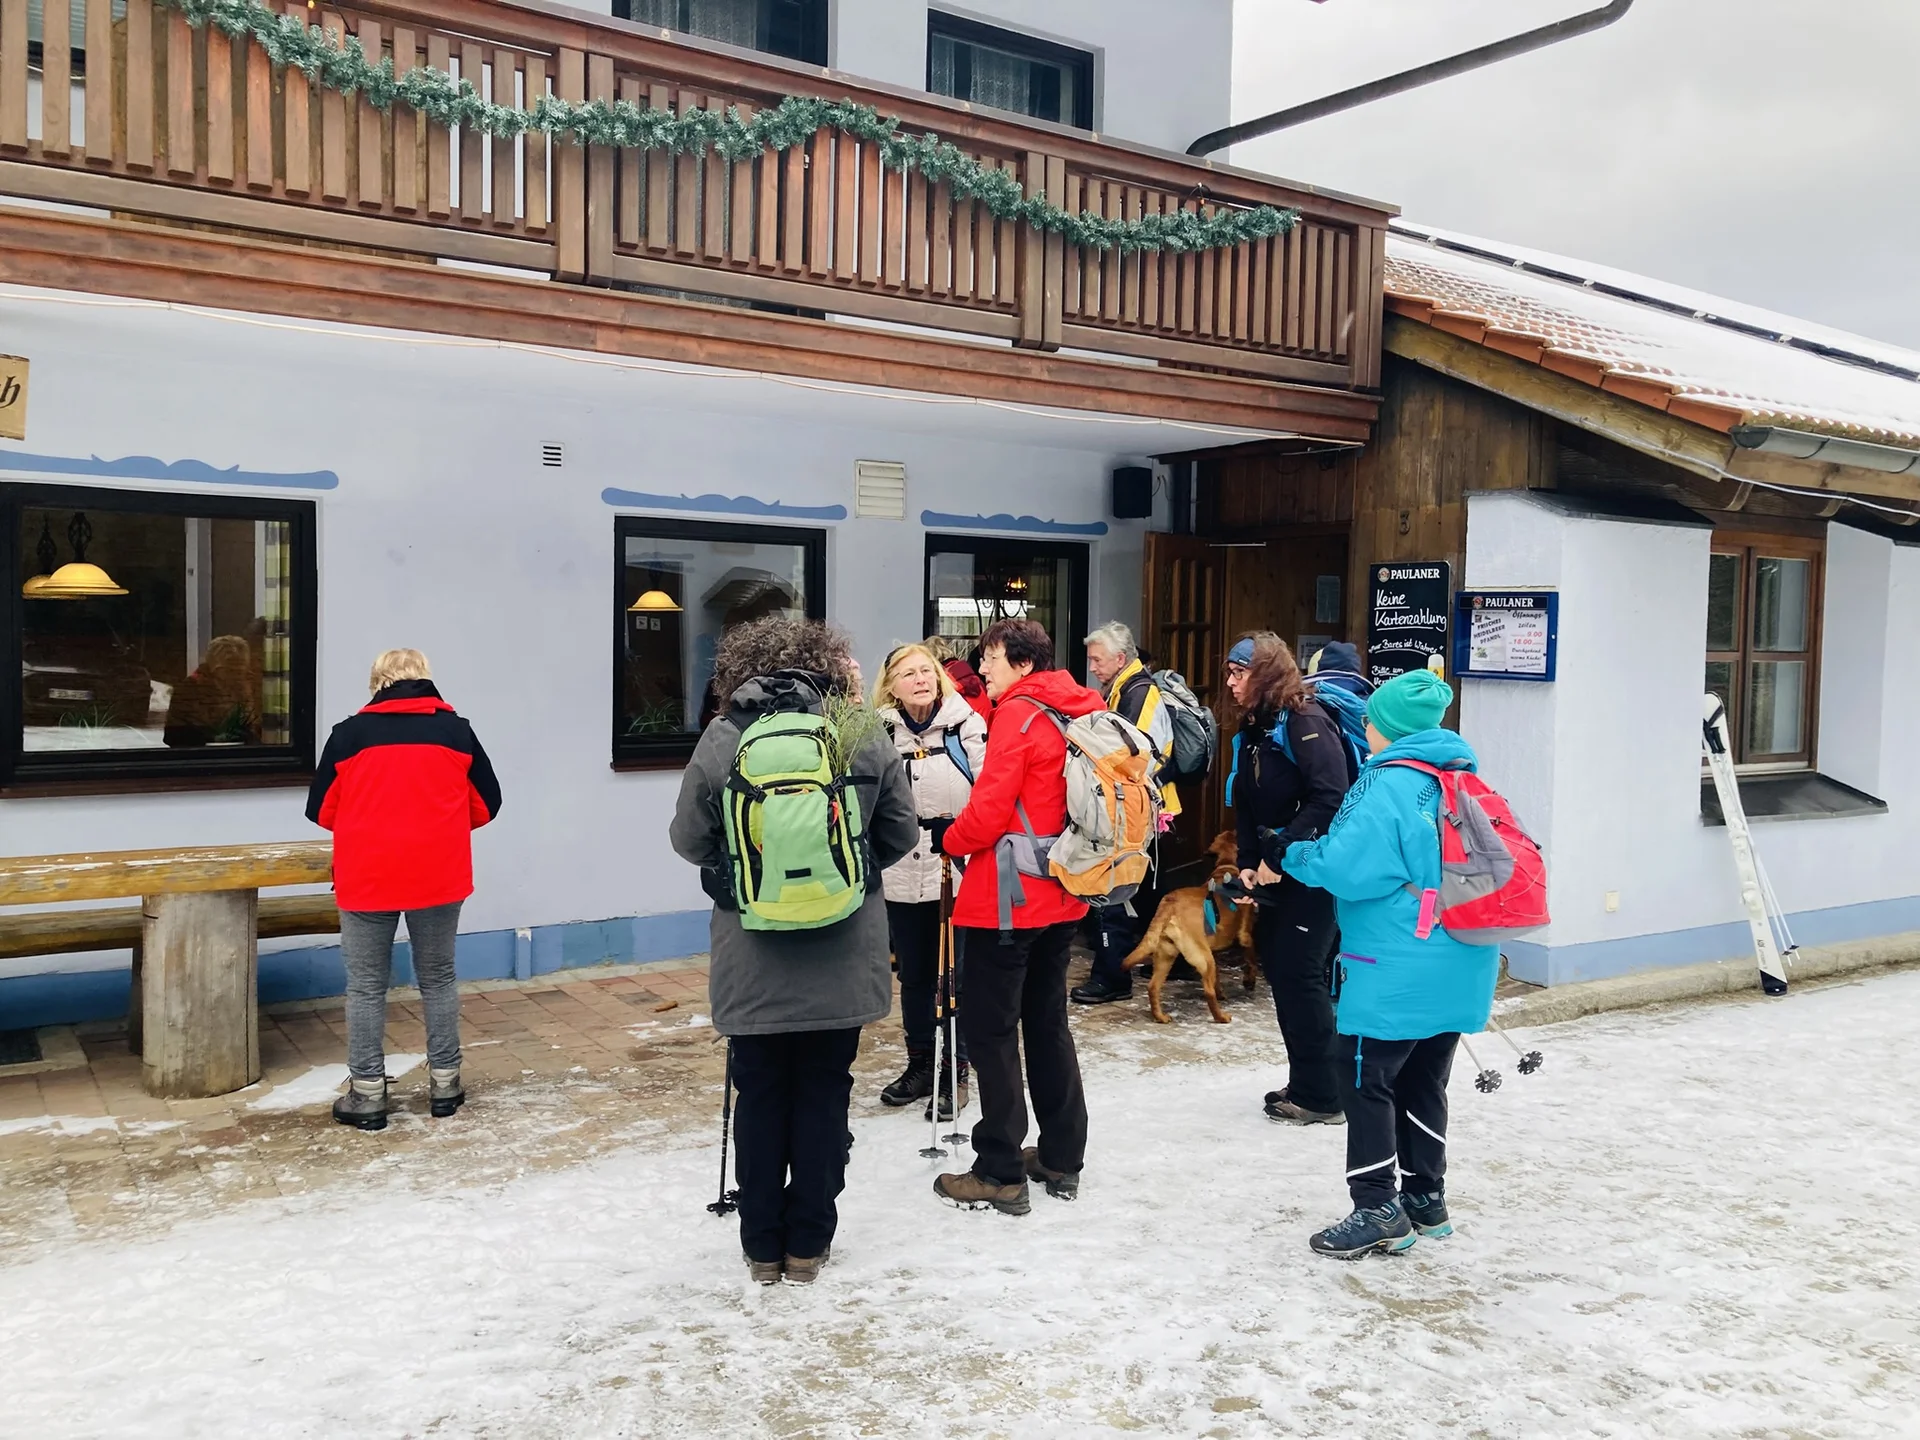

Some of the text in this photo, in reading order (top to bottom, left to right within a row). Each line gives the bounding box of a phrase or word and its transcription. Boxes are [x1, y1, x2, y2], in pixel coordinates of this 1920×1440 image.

[0, 375, 21, 409] h
[1390, 568, 1440, 580] PAULANER
[1376, 589, 1406, 607] Keine
[1485, 597, 1534, 608] PAULANER
[1374, 608, 1447, 632] Kartenzahlung
[1382, 639, 1403, 649] Bares
[1404, 638, 1413, 648] ist
